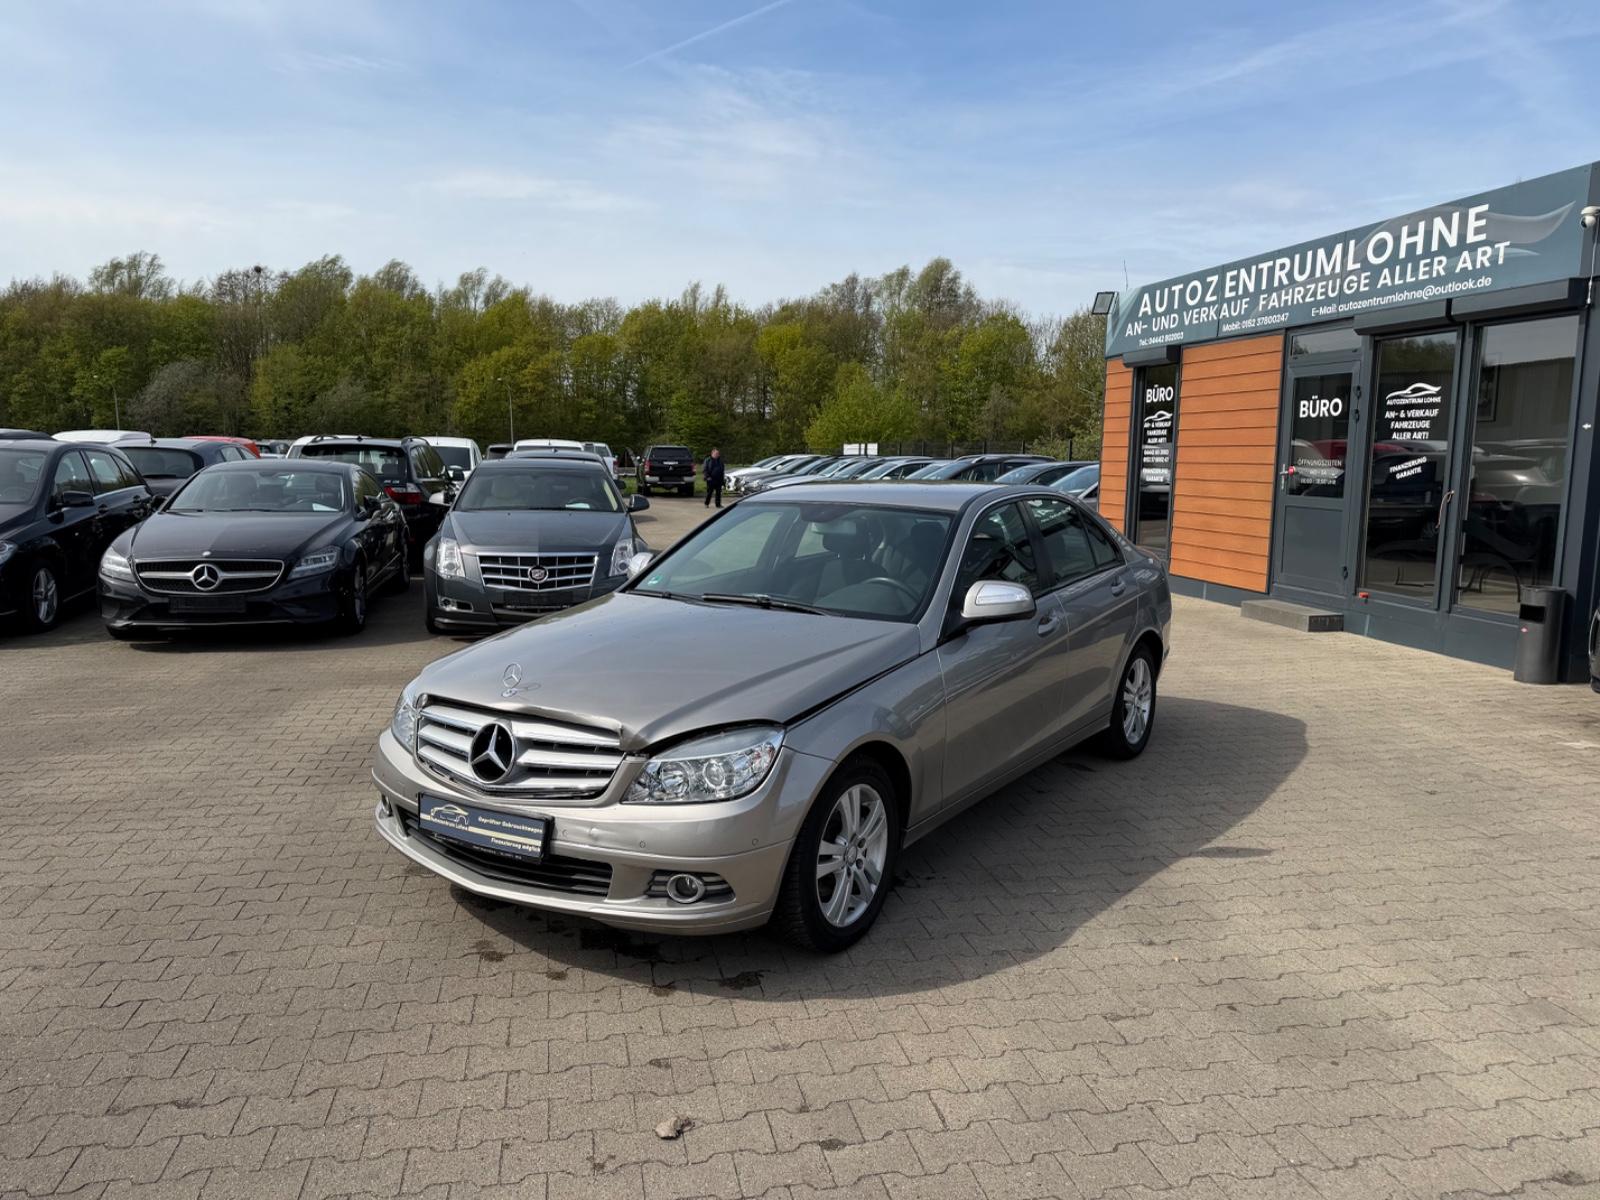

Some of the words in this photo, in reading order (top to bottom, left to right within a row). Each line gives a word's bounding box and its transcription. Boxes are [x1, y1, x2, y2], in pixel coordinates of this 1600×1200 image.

[1125, 321, 1148, 336] AN-
[1152, 313, 1179, 331] UND
[1183, 297, 1250, 326] VERKAUF
[1258, 272, 1371, 312] FAHRZEUGE
[1377, 255, 1448, 288] ALLER
[1455, 241, 1511, 273] ART
[1311, 303, 1338, 317] E-Mail:
[1338, 275, 1492, 312] autozentrumlohne@outlook.de
[1146, 384, 1174, 403] BÜRO
[1299, 395, 1342, 418] BÜRO
[1385, 410, 1398, 419] AN-
[1400, 410, 1405, 418] &
[1407, 409, 1439, 418] VERKAUF
[1390, 420, 1431, 429] FAHRZEUGE
[1392, 431, 1411, 440] ALLER
